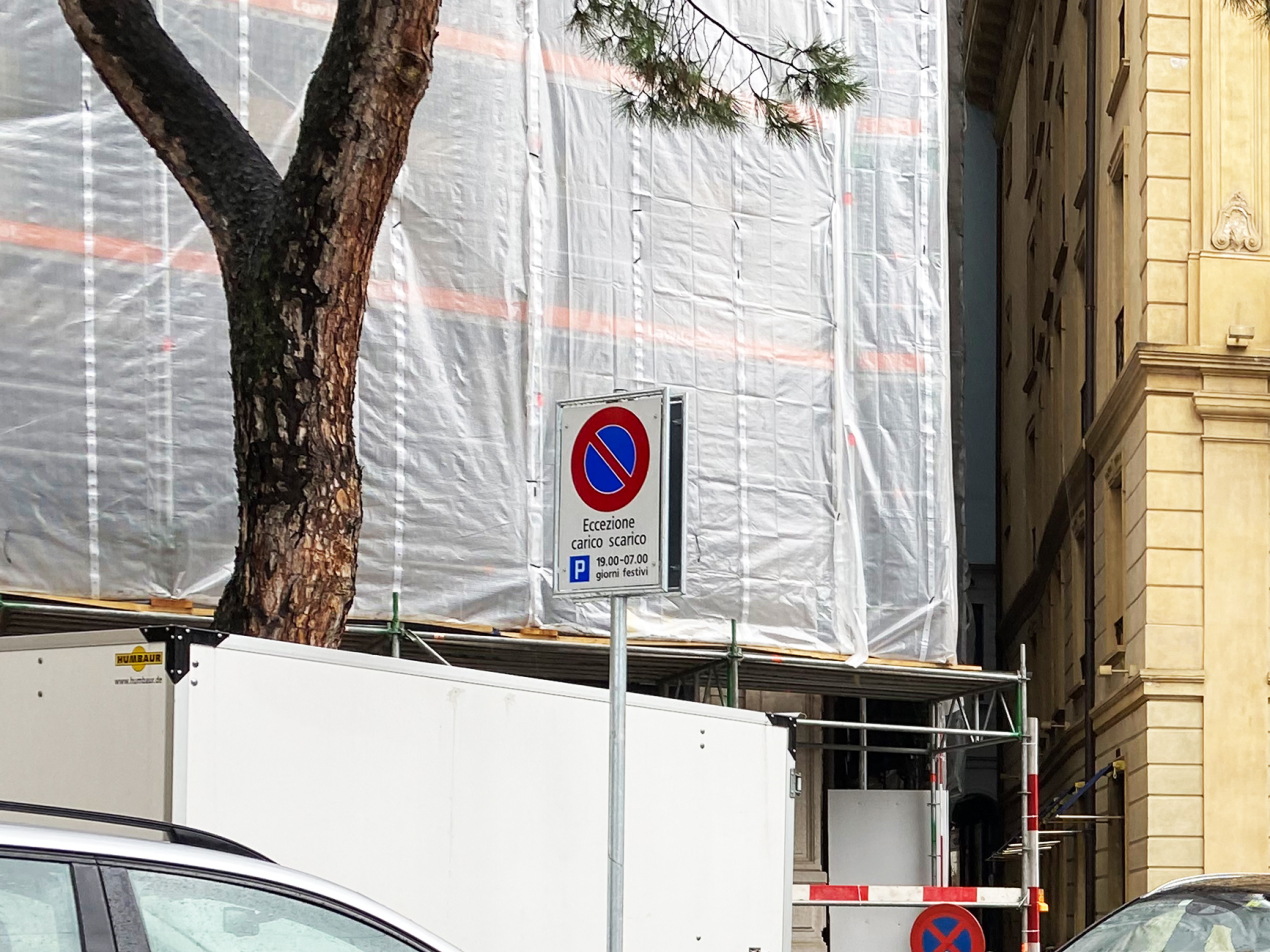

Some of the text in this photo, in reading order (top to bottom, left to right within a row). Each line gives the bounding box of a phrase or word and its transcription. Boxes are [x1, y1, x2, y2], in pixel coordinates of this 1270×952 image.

[583, 516, 635, 532] Eccezione
[571, 531, 647, 550] carico scarico
[575, 554, 648, 580] P 19.00-07.00
[596, 565, 649, 581] giorni festivi
[117, 654, 161, 664] HUMBAUR
